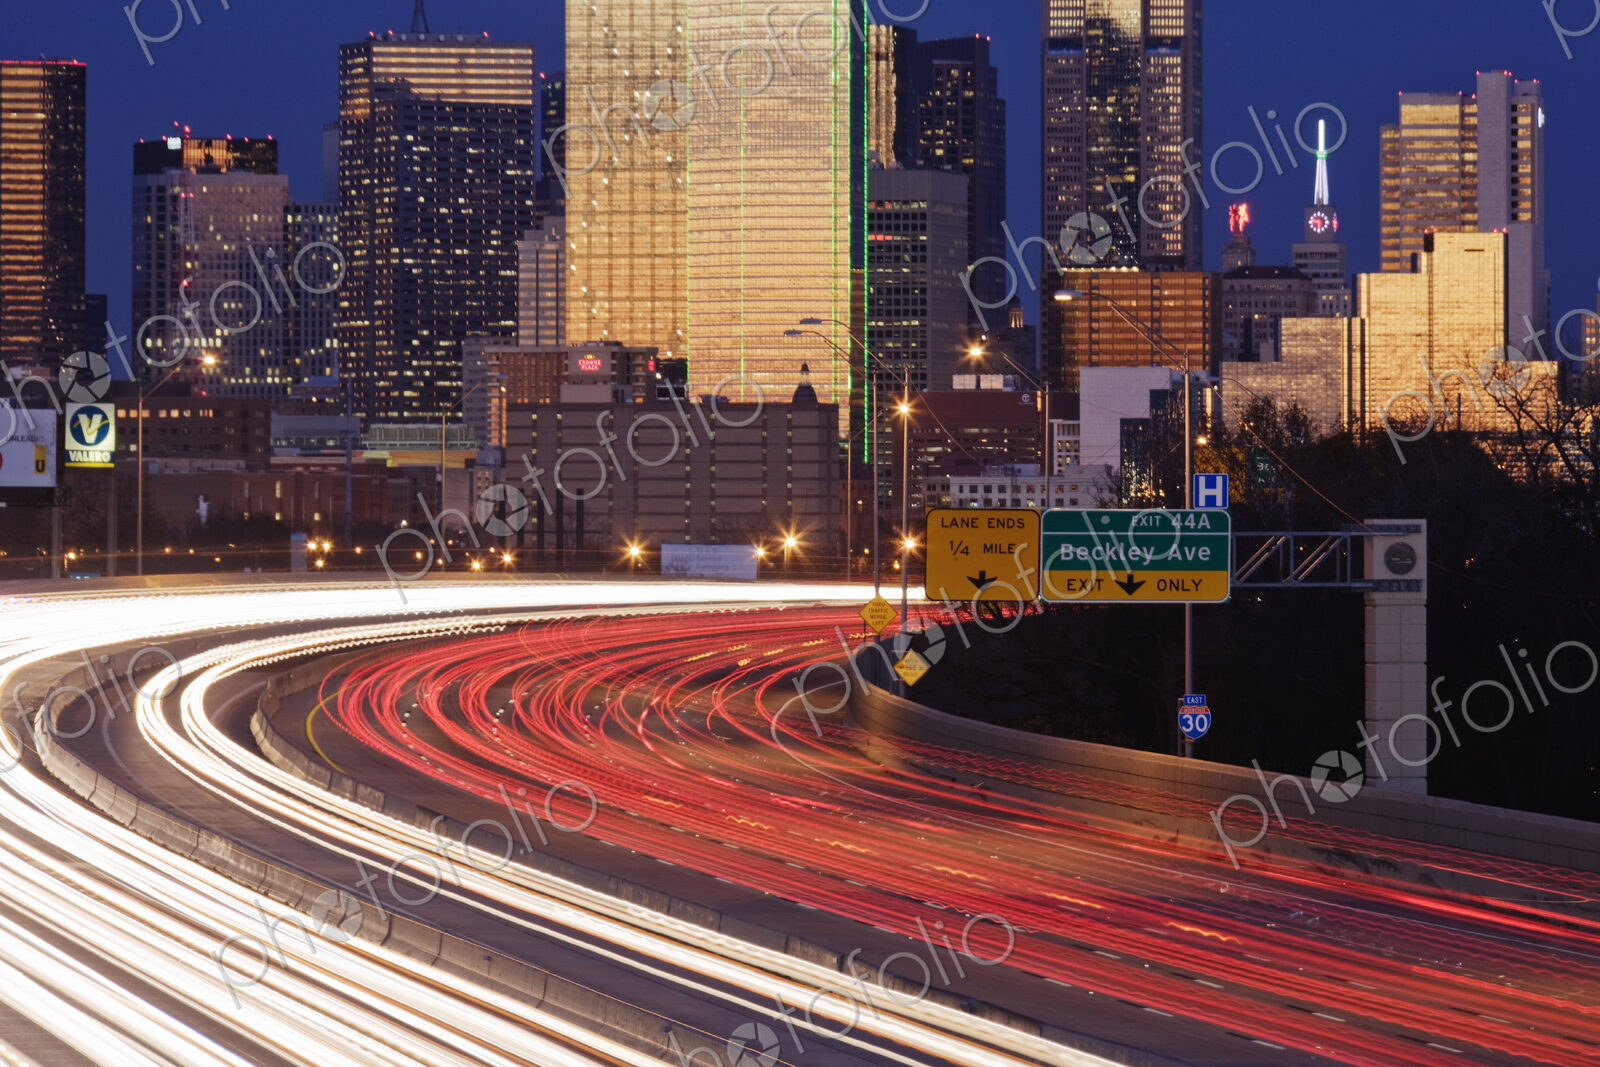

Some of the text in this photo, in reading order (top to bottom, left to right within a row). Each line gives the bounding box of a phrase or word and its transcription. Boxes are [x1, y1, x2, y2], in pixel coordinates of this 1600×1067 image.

[69, 450, 111, 463] VALERO
[1199, 476, 1223, 507] H
[941, 518, 1025, 529] LANE ENDS
[1131, 513, 1211, 529] EXIT 44A
[949, 540, 1016, 556] 1/4 MILE
[1060, 542, 1211, 566] Beckley Ave
[1066, 578, 1203, 592] EXIT ONLY
[1186, 696, 1203, 704] EAST
[1181, 714, 1208, 732] 30
